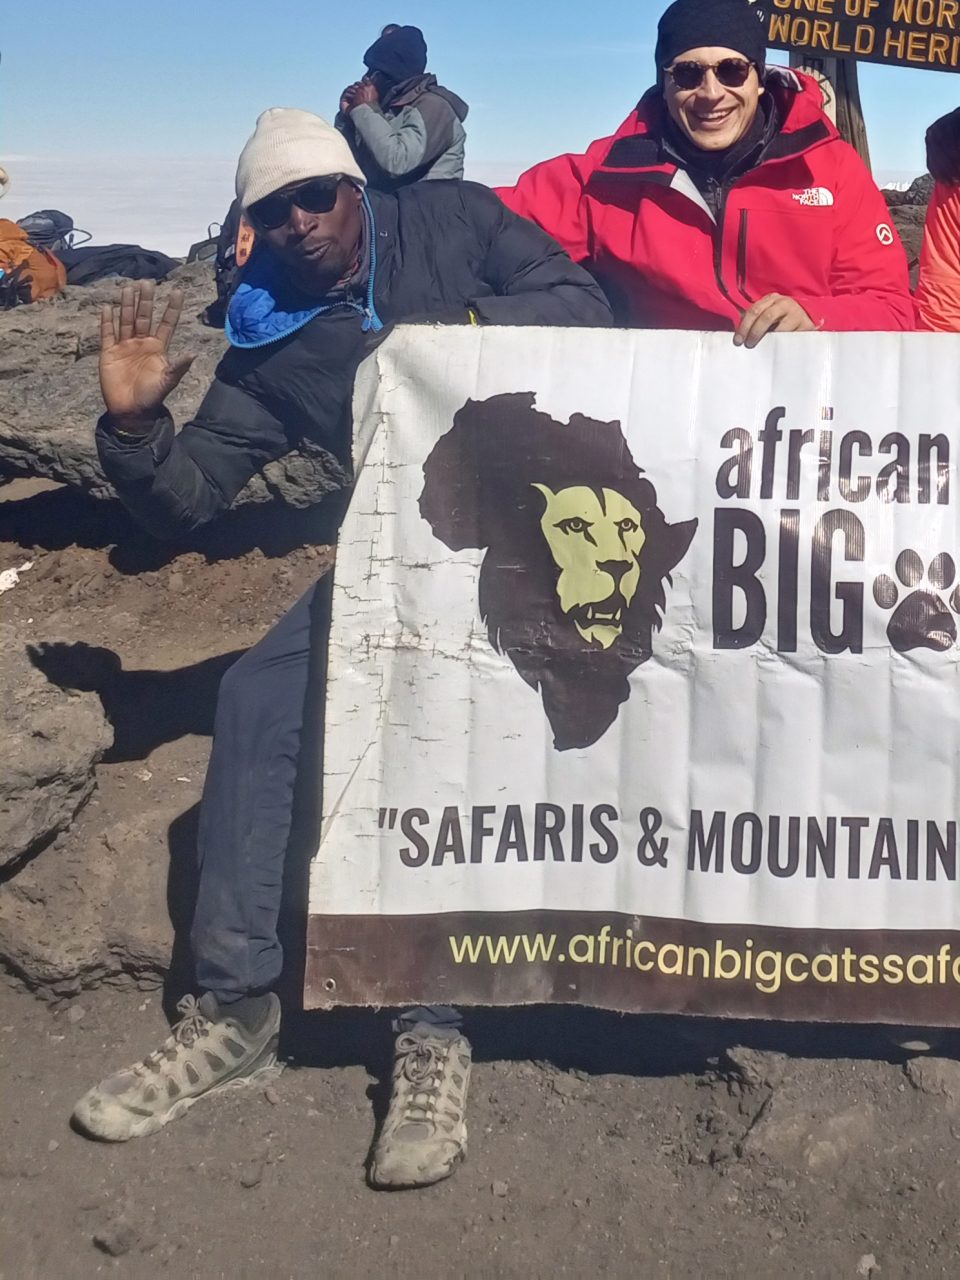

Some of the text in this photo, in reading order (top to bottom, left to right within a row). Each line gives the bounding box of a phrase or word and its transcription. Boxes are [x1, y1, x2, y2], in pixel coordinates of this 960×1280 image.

[768, 14, 873, 54] WORLD
[792, 193, 819, 201] NORTH
[716, 406, 950, 505] african
[713, 508, 865, 655] BIG
[377, 806, 618, 868] "SAFARIS
[637, 817, 668, 866] &
[688, 810, 956, 882] MOUNTAIN
